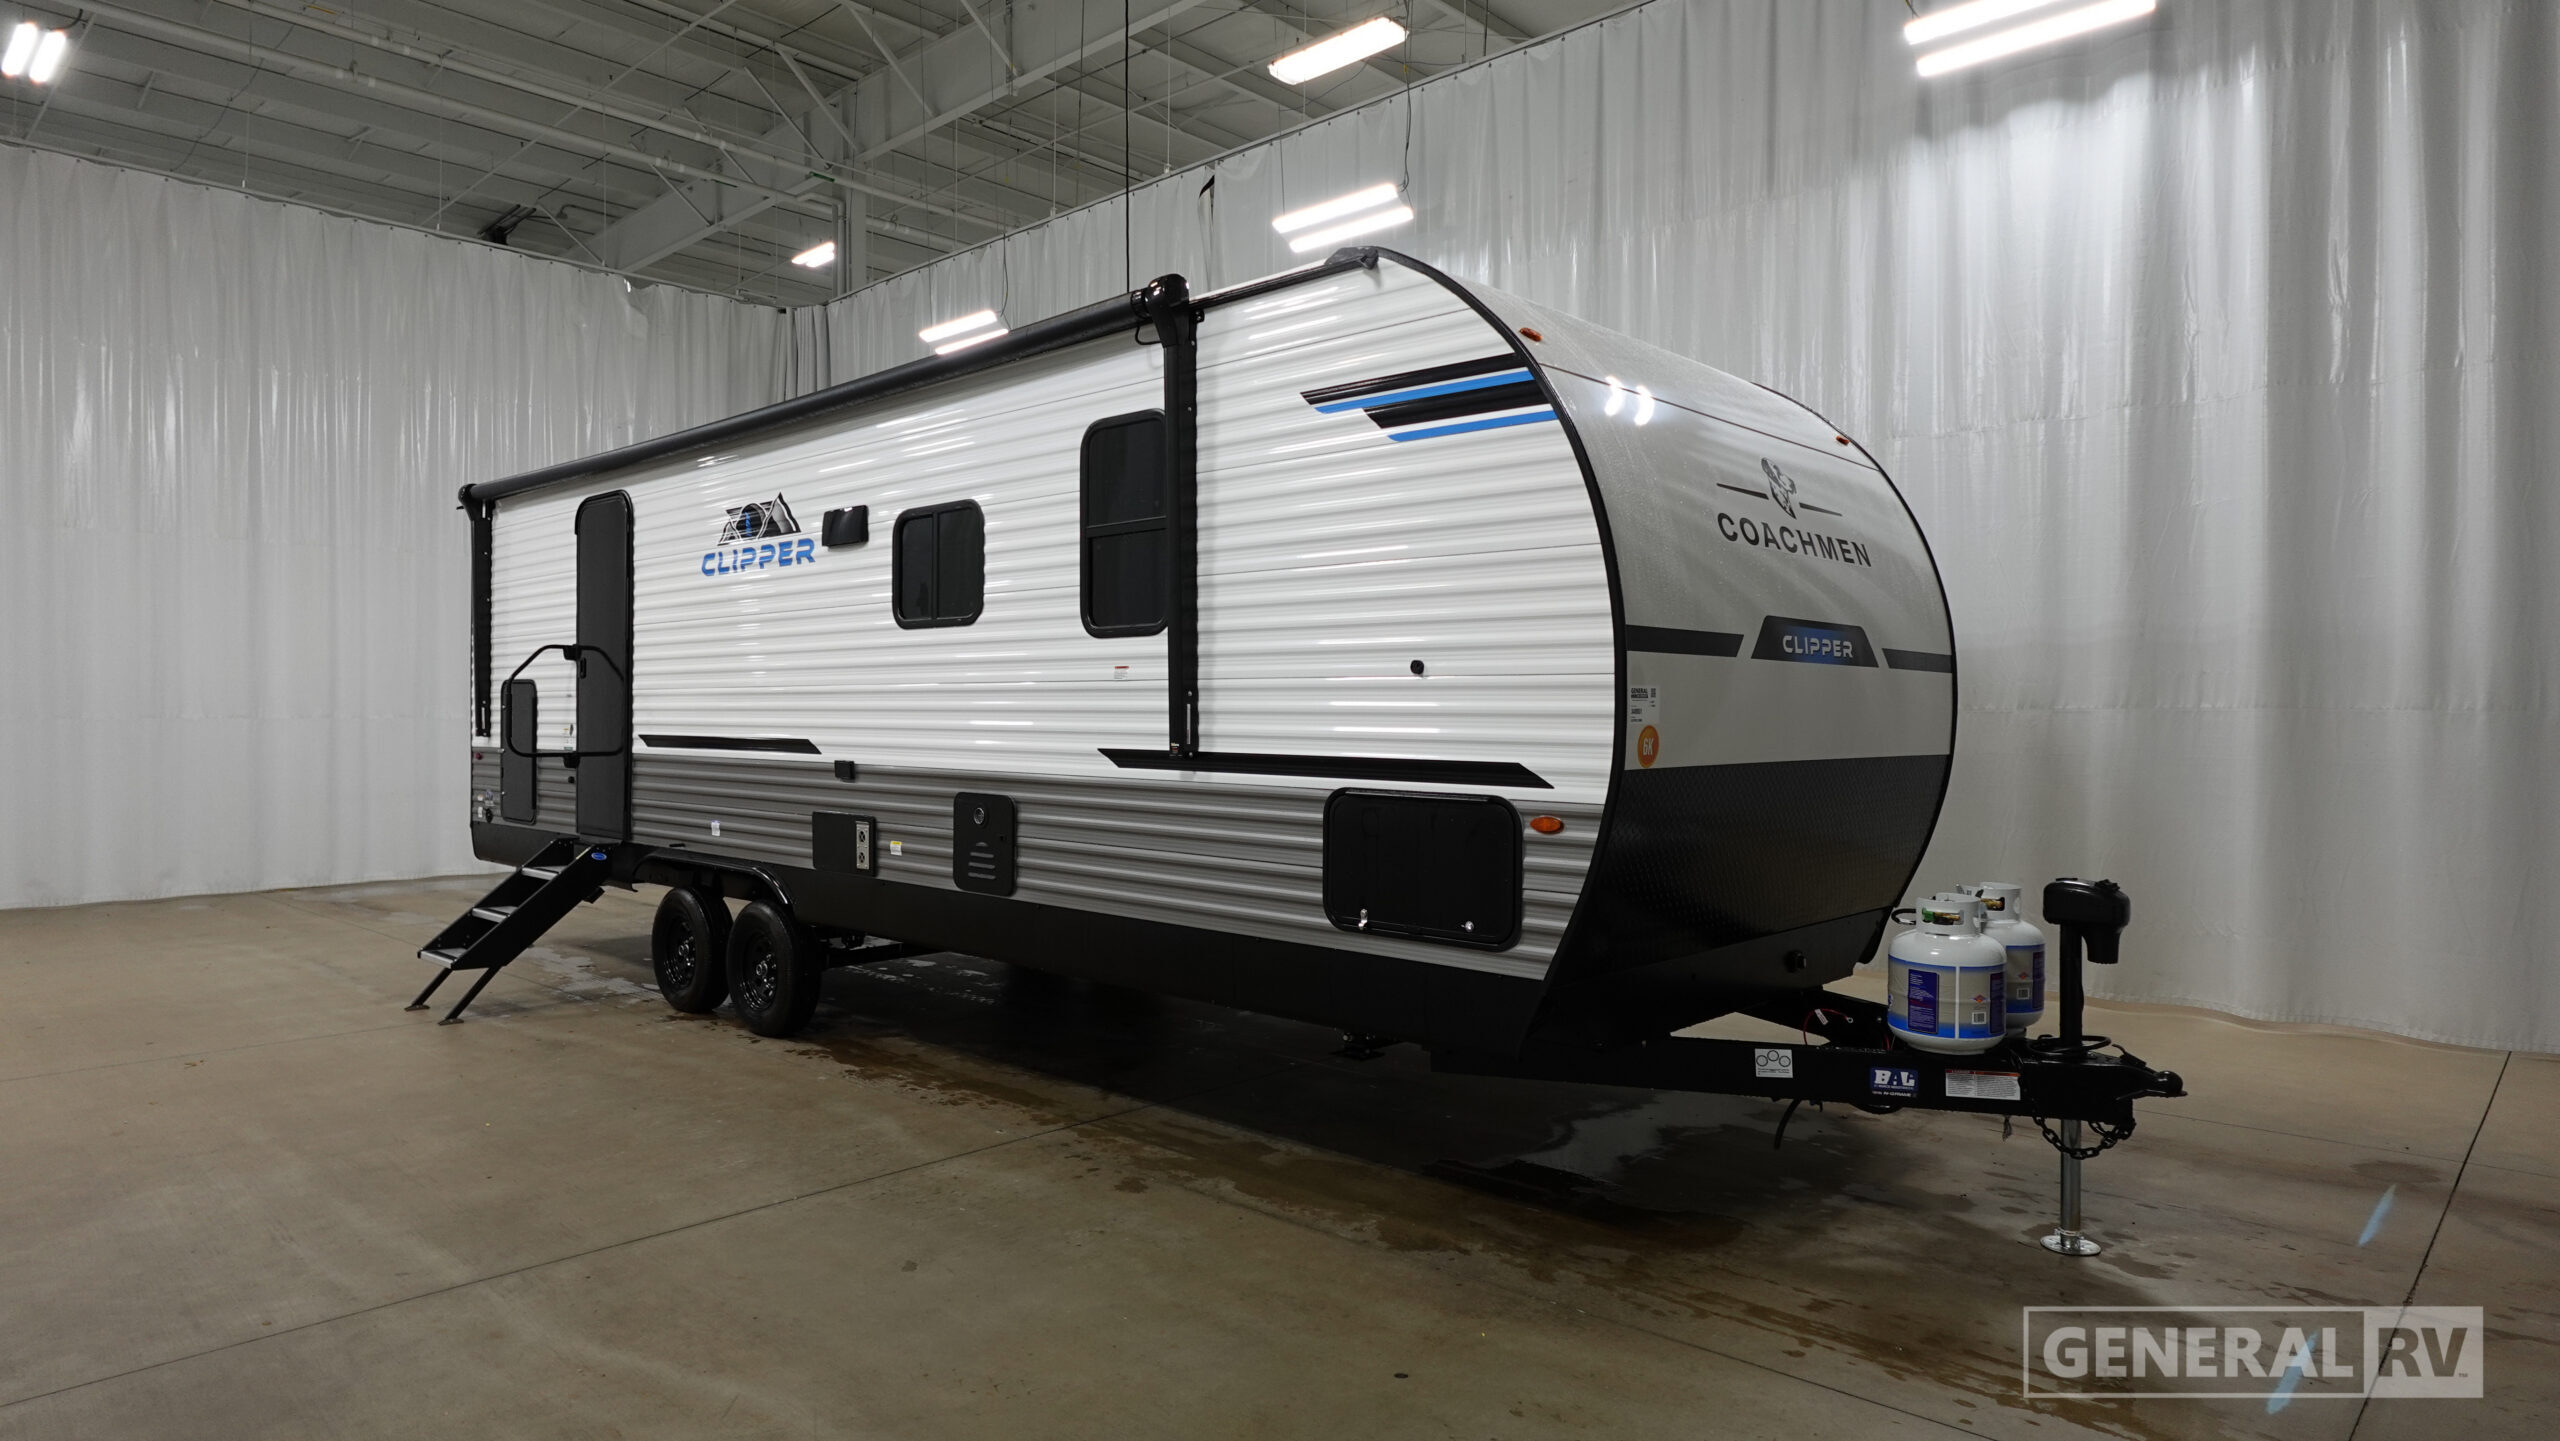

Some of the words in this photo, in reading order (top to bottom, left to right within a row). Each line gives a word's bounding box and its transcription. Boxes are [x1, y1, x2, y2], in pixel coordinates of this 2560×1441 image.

[1717, 512, 1872, 568] COACHMEN
[701, 538, 816, 576] CLIPPER
[1782, 635, 1854, 658] CLIPPER
[1874, 1069, 1915, 1087] BAL
